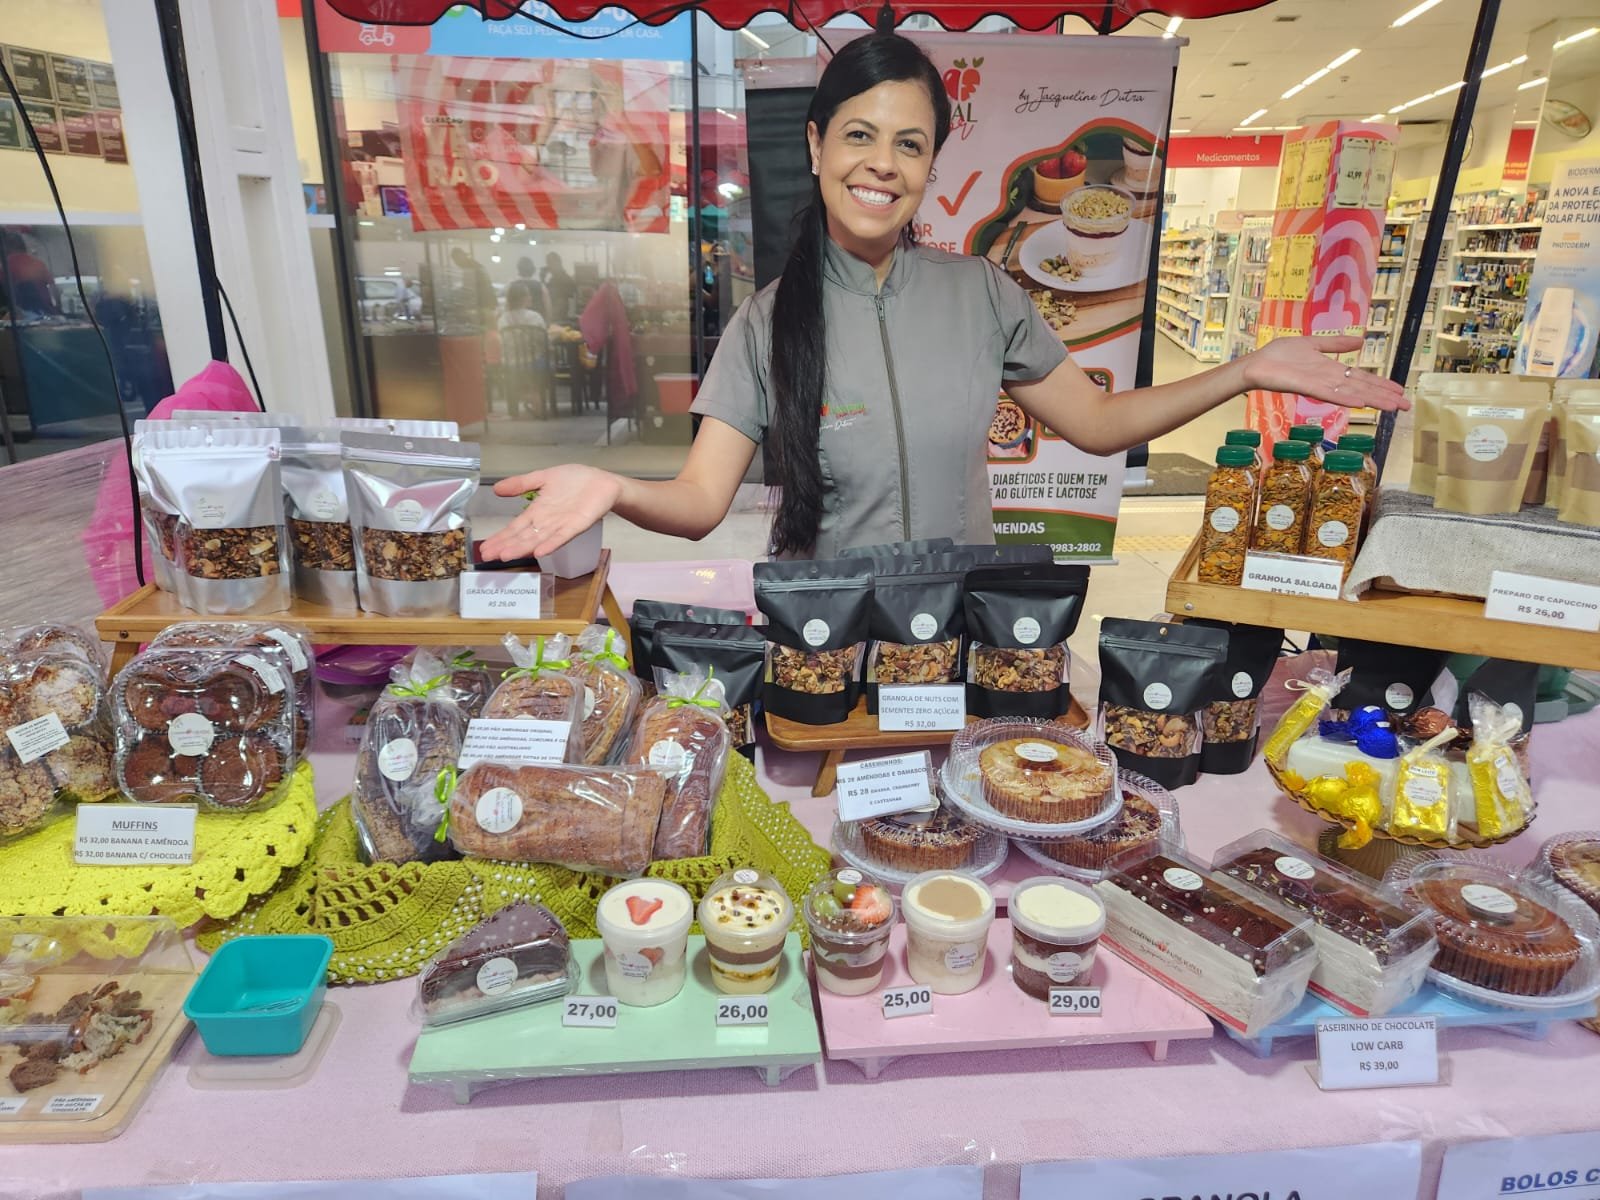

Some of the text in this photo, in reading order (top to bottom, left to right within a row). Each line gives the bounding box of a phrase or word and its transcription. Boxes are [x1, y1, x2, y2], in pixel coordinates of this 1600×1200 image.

[1028, 86, 1097, 112] Jacqueline
[1101, 89, 1157, 107] Dutra
[951, 103, 978, 122] AL
[1196, 153, 1260, 162] Medicamentos
[1567, 167, 1600, 177] BIODERM
[1554, 186, 1600, 197] A NOVA E
[1562, 200, 1600, 212] PROTEÇ
[1545, 214, 1573, 223] SOLAR
[993, 471, 1108, 485] DIABÉTICOS E QUEM TEM
[995, 486, 1098, 499] AO GLÚTEN E LACTOSE
[993, 522, 1045, 535] MENDAS
[1248, 572, 1338, 591] GRANOLA SALGADA
[1492, 588, 1598, 610] PREPARO DE CAPUCCINO
[1518, 605, 1565, 620] R$ 26,00
[933, 707, 960, 715] AÇÚCAR
[904, 720, 914, 728] R$
[847, 788, 858, 797] R$
[859, 787, 869, 796] 28
[112, 820, 158, 830] MUFFINS
[79, 836, 89, 844] R$
[90, 837, 109, 845] 32,00
[110, 837, 143, 845] BANANA
[150, 836, 189, 846] AMÊNDOA
[85, 850, 104, 858] 32,00
[105, 851, 138, 859] BANANA
[139, 851, 149, 860] C/
[150, 852, 192, 860] CHOCOLATE
[883, 990, 931, 1008] 25,00
[1051, 994, 1101, 1011] 29,00
[567, 1003, 617, 1020] 27,00
[719, 1004, 768, 1020] 26,00
[1318, 1021, 1435, 1033] CASEIRINHO DE CHOCOLATE
[1351, 1041, 1404, 1051] LOW CARB
[1359, 1060, 1399, 1071] R$ 39,00
[1500, 1168, 1600, 1192] BOLOS C
